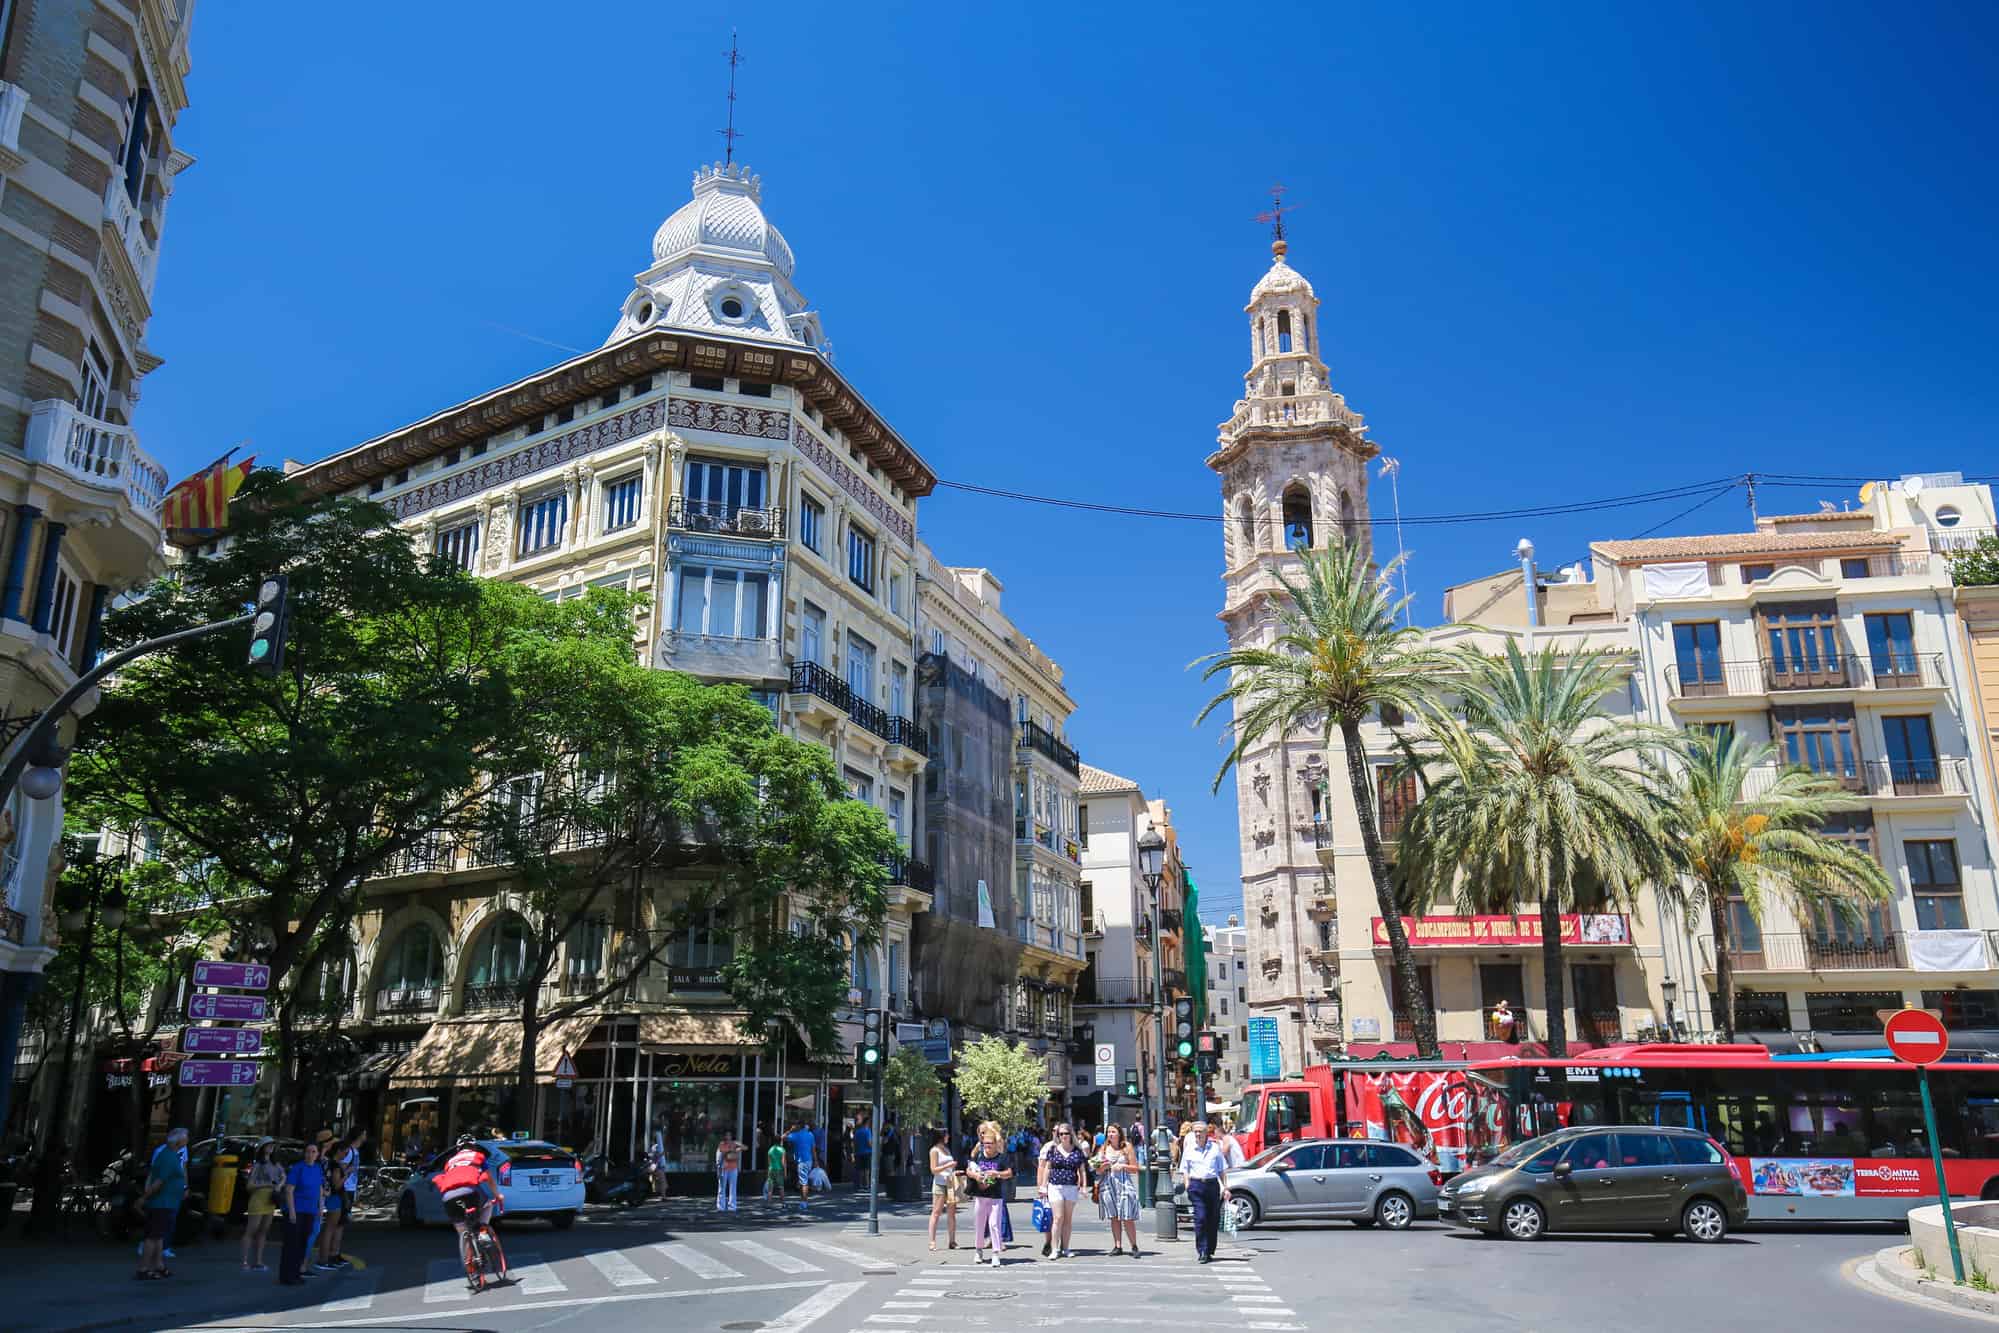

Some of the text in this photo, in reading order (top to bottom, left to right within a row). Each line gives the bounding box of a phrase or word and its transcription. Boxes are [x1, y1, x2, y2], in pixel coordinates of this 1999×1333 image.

[664, 1054, 729, 1077] Nela
[1565, 1066, 1599, 1075] EMT
[1855, 1168, 1880, 1177] TERRA
